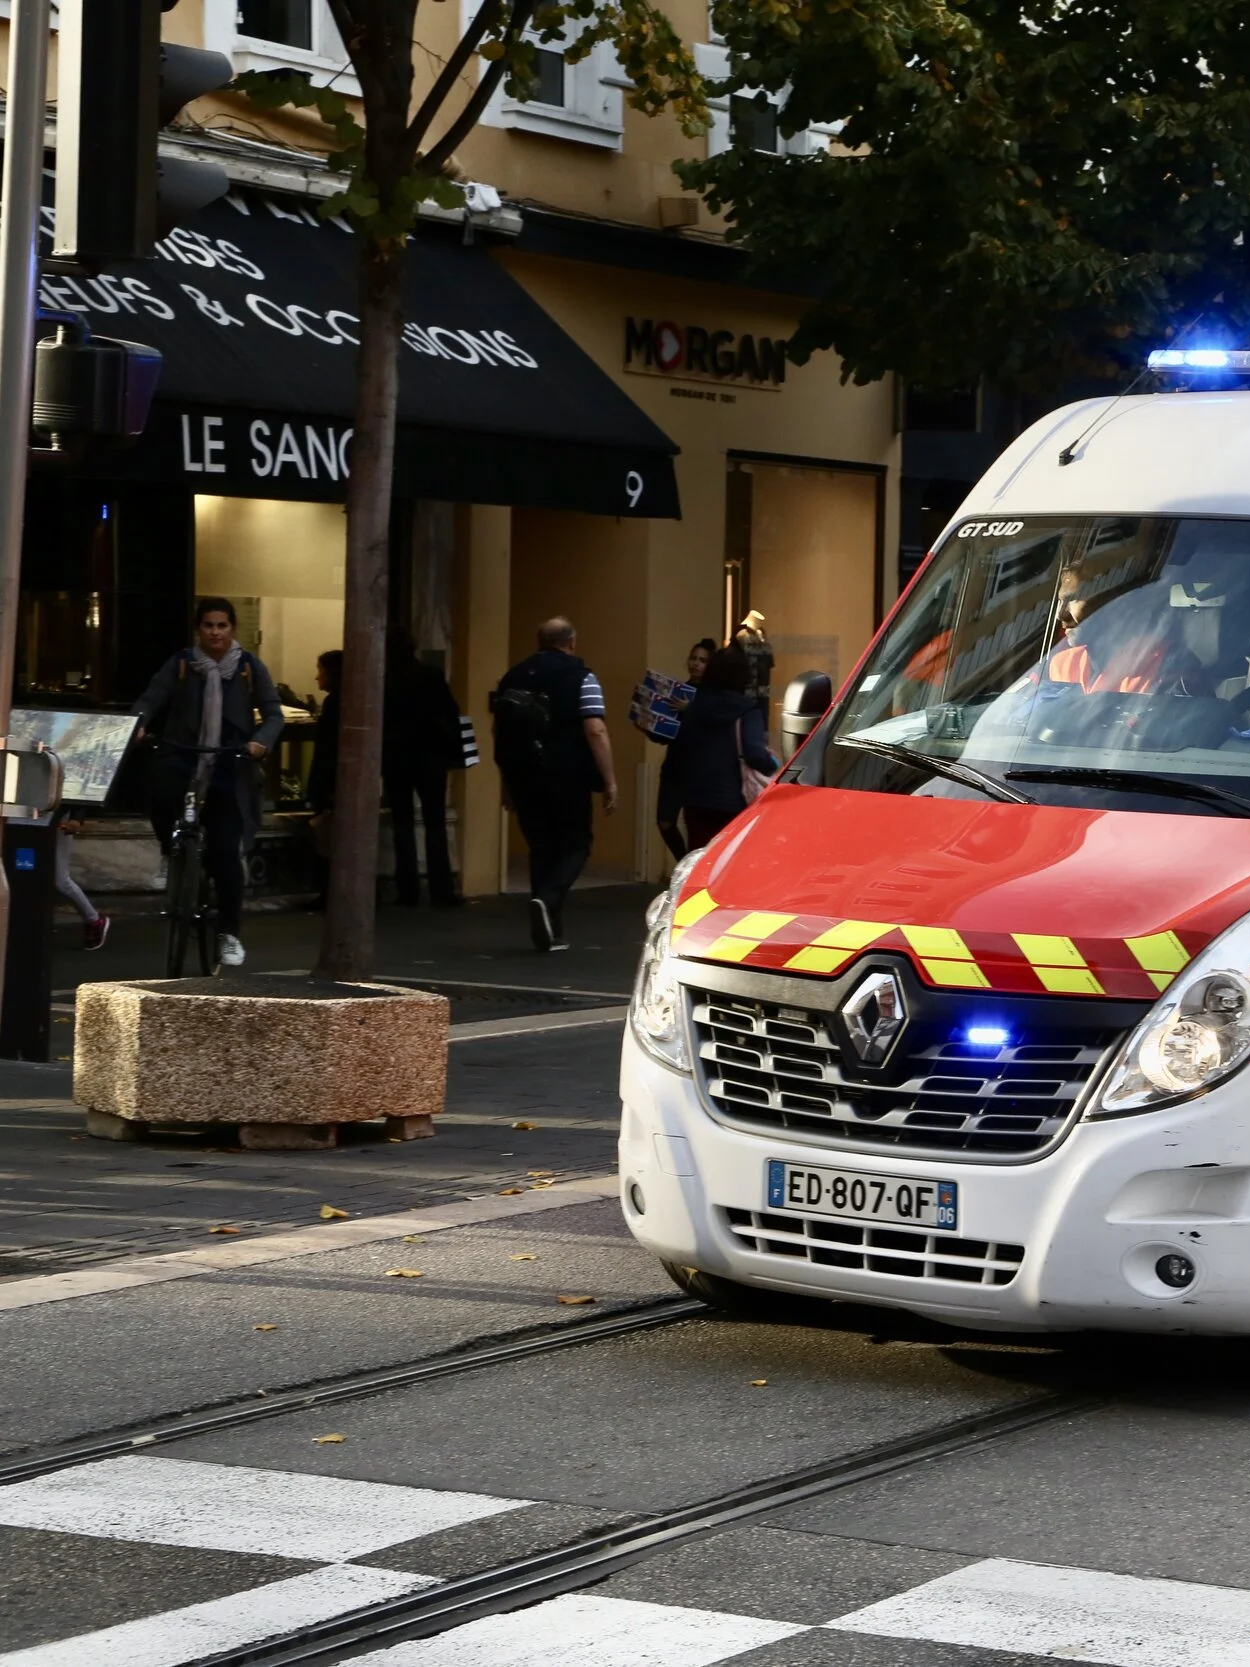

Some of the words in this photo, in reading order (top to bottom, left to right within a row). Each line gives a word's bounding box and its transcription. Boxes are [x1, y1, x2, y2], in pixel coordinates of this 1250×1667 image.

[179, 283, 245, 327] &
[246, 293, 538, 368] OCCSIONS
[624, 316, 788, 384] MORGAN
[182, 414, 227, 473] LE
[625, 470, 644, 508] 9
[957, 523, 988, 538] GT
[982, 521, 1025, 537] SUD
[773, 1188, 780, 1198] F
[938, 1207, 955, 1224] 06
